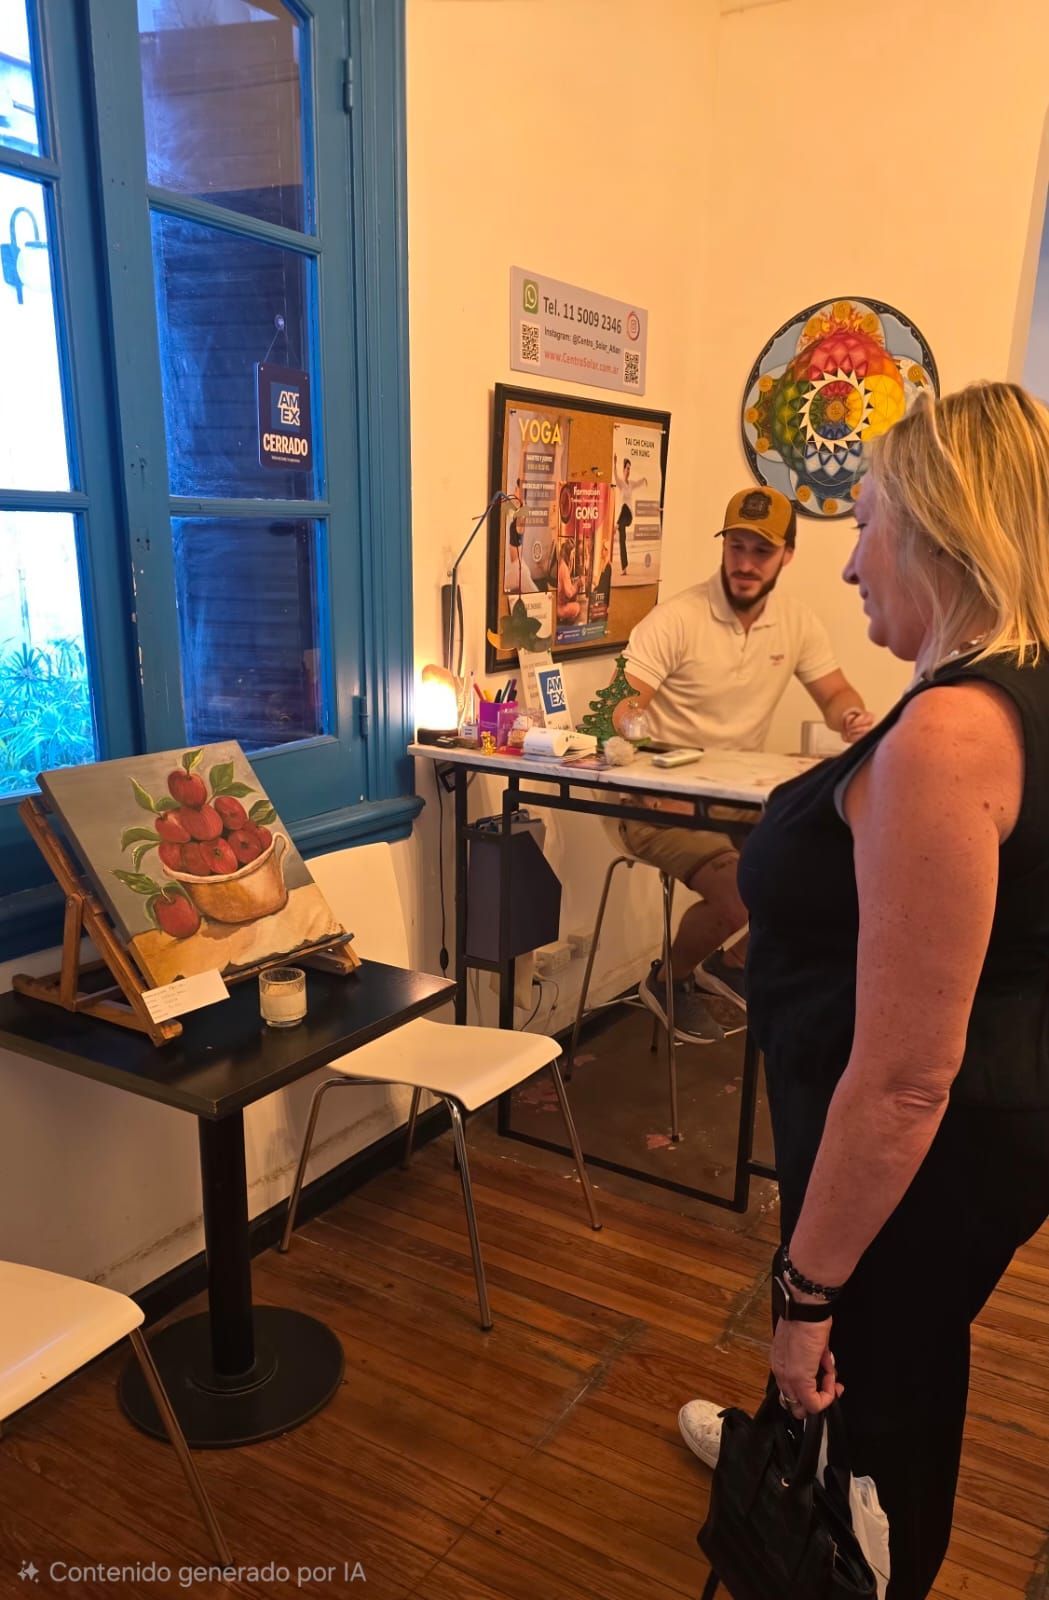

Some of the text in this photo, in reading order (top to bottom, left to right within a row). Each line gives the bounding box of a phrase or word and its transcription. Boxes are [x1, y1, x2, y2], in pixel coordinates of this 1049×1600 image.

[543, 296, 622, 334] Tel. 11 5009 2346
[518, 417, 562, 446] YOGA
[624, 437, 633, 446] TAI
[263, 433, 308, 457] CERRADO
[575, 506, 599, 520] GONG
